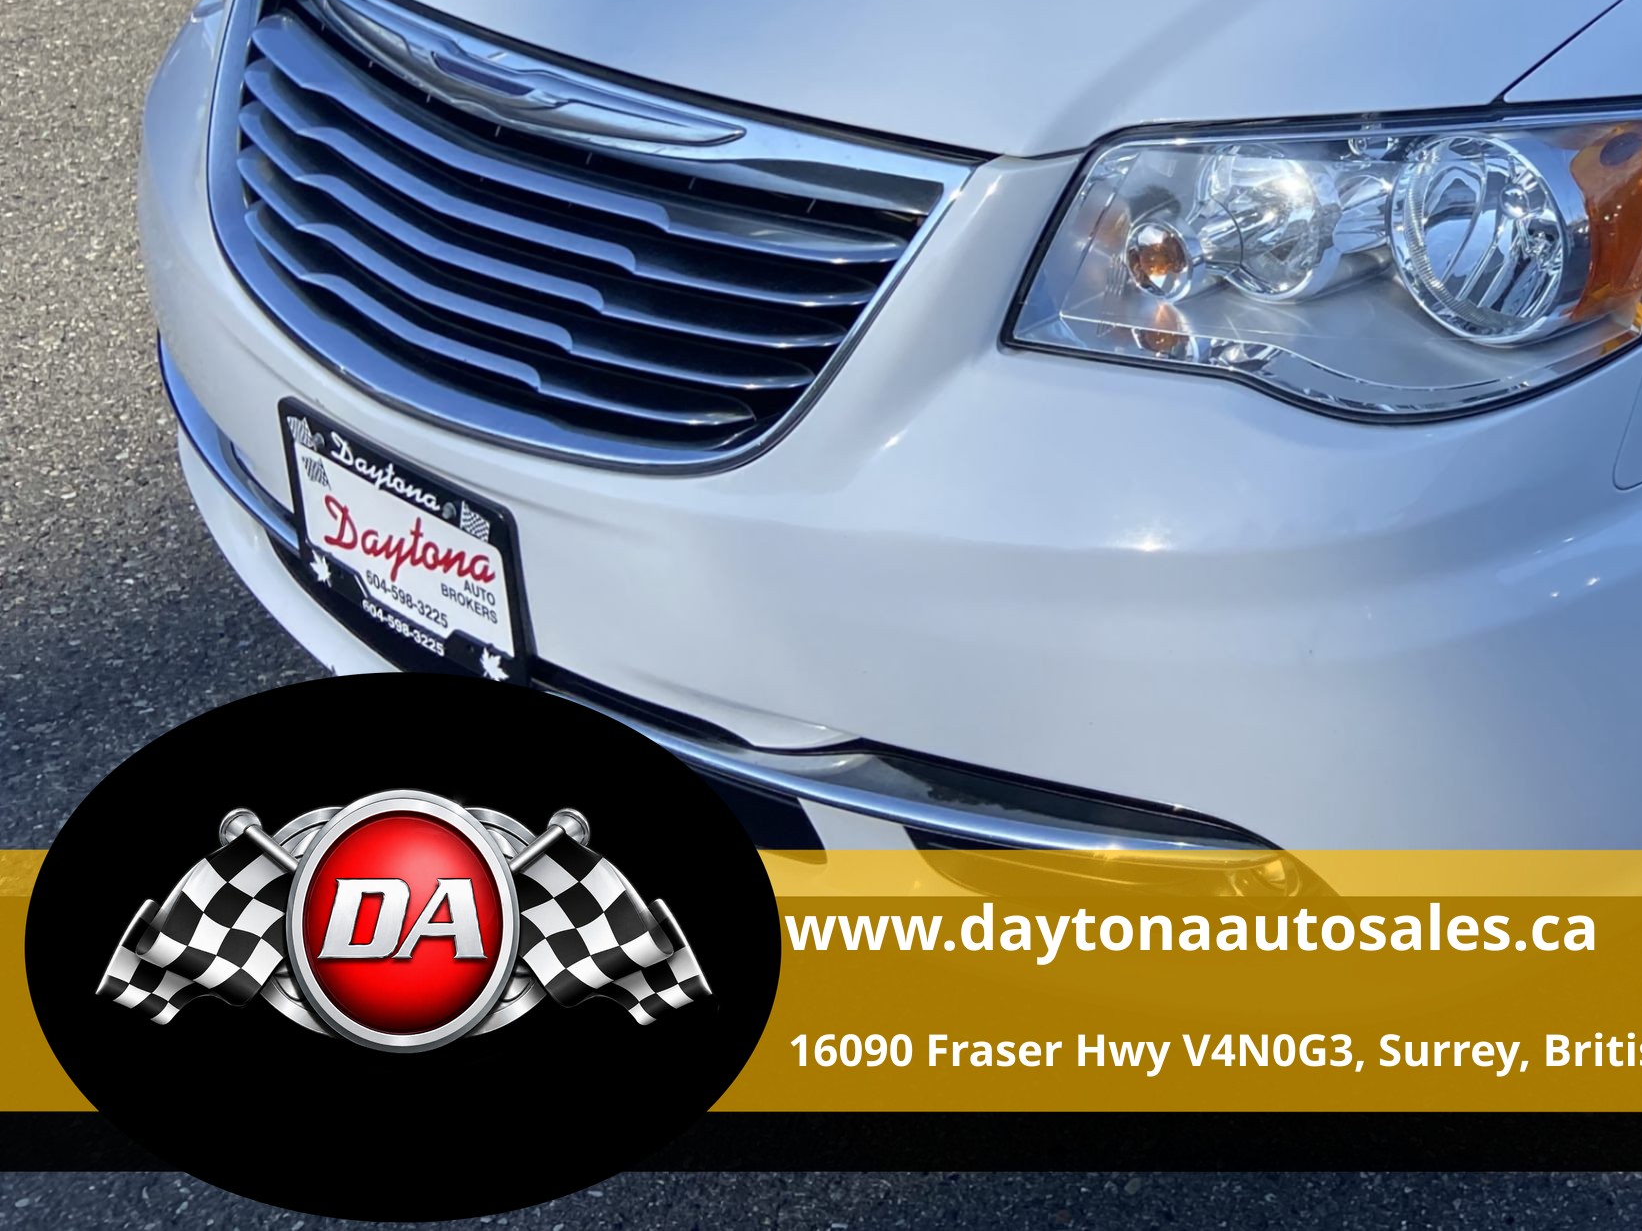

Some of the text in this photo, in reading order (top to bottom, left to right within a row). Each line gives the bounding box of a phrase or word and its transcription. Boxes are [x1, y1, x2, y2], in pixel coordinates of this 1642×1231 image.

[331, 431, 441, 511] Daytona
[324, 494, 496, 583] Daytona
[365, 571, 449, 629] 604-598-3225
[441, 583, 498, 624] BROKERS
[463, 580, 496, 606] AUTO
[362, 599, 445, 657] 604-598-3225
